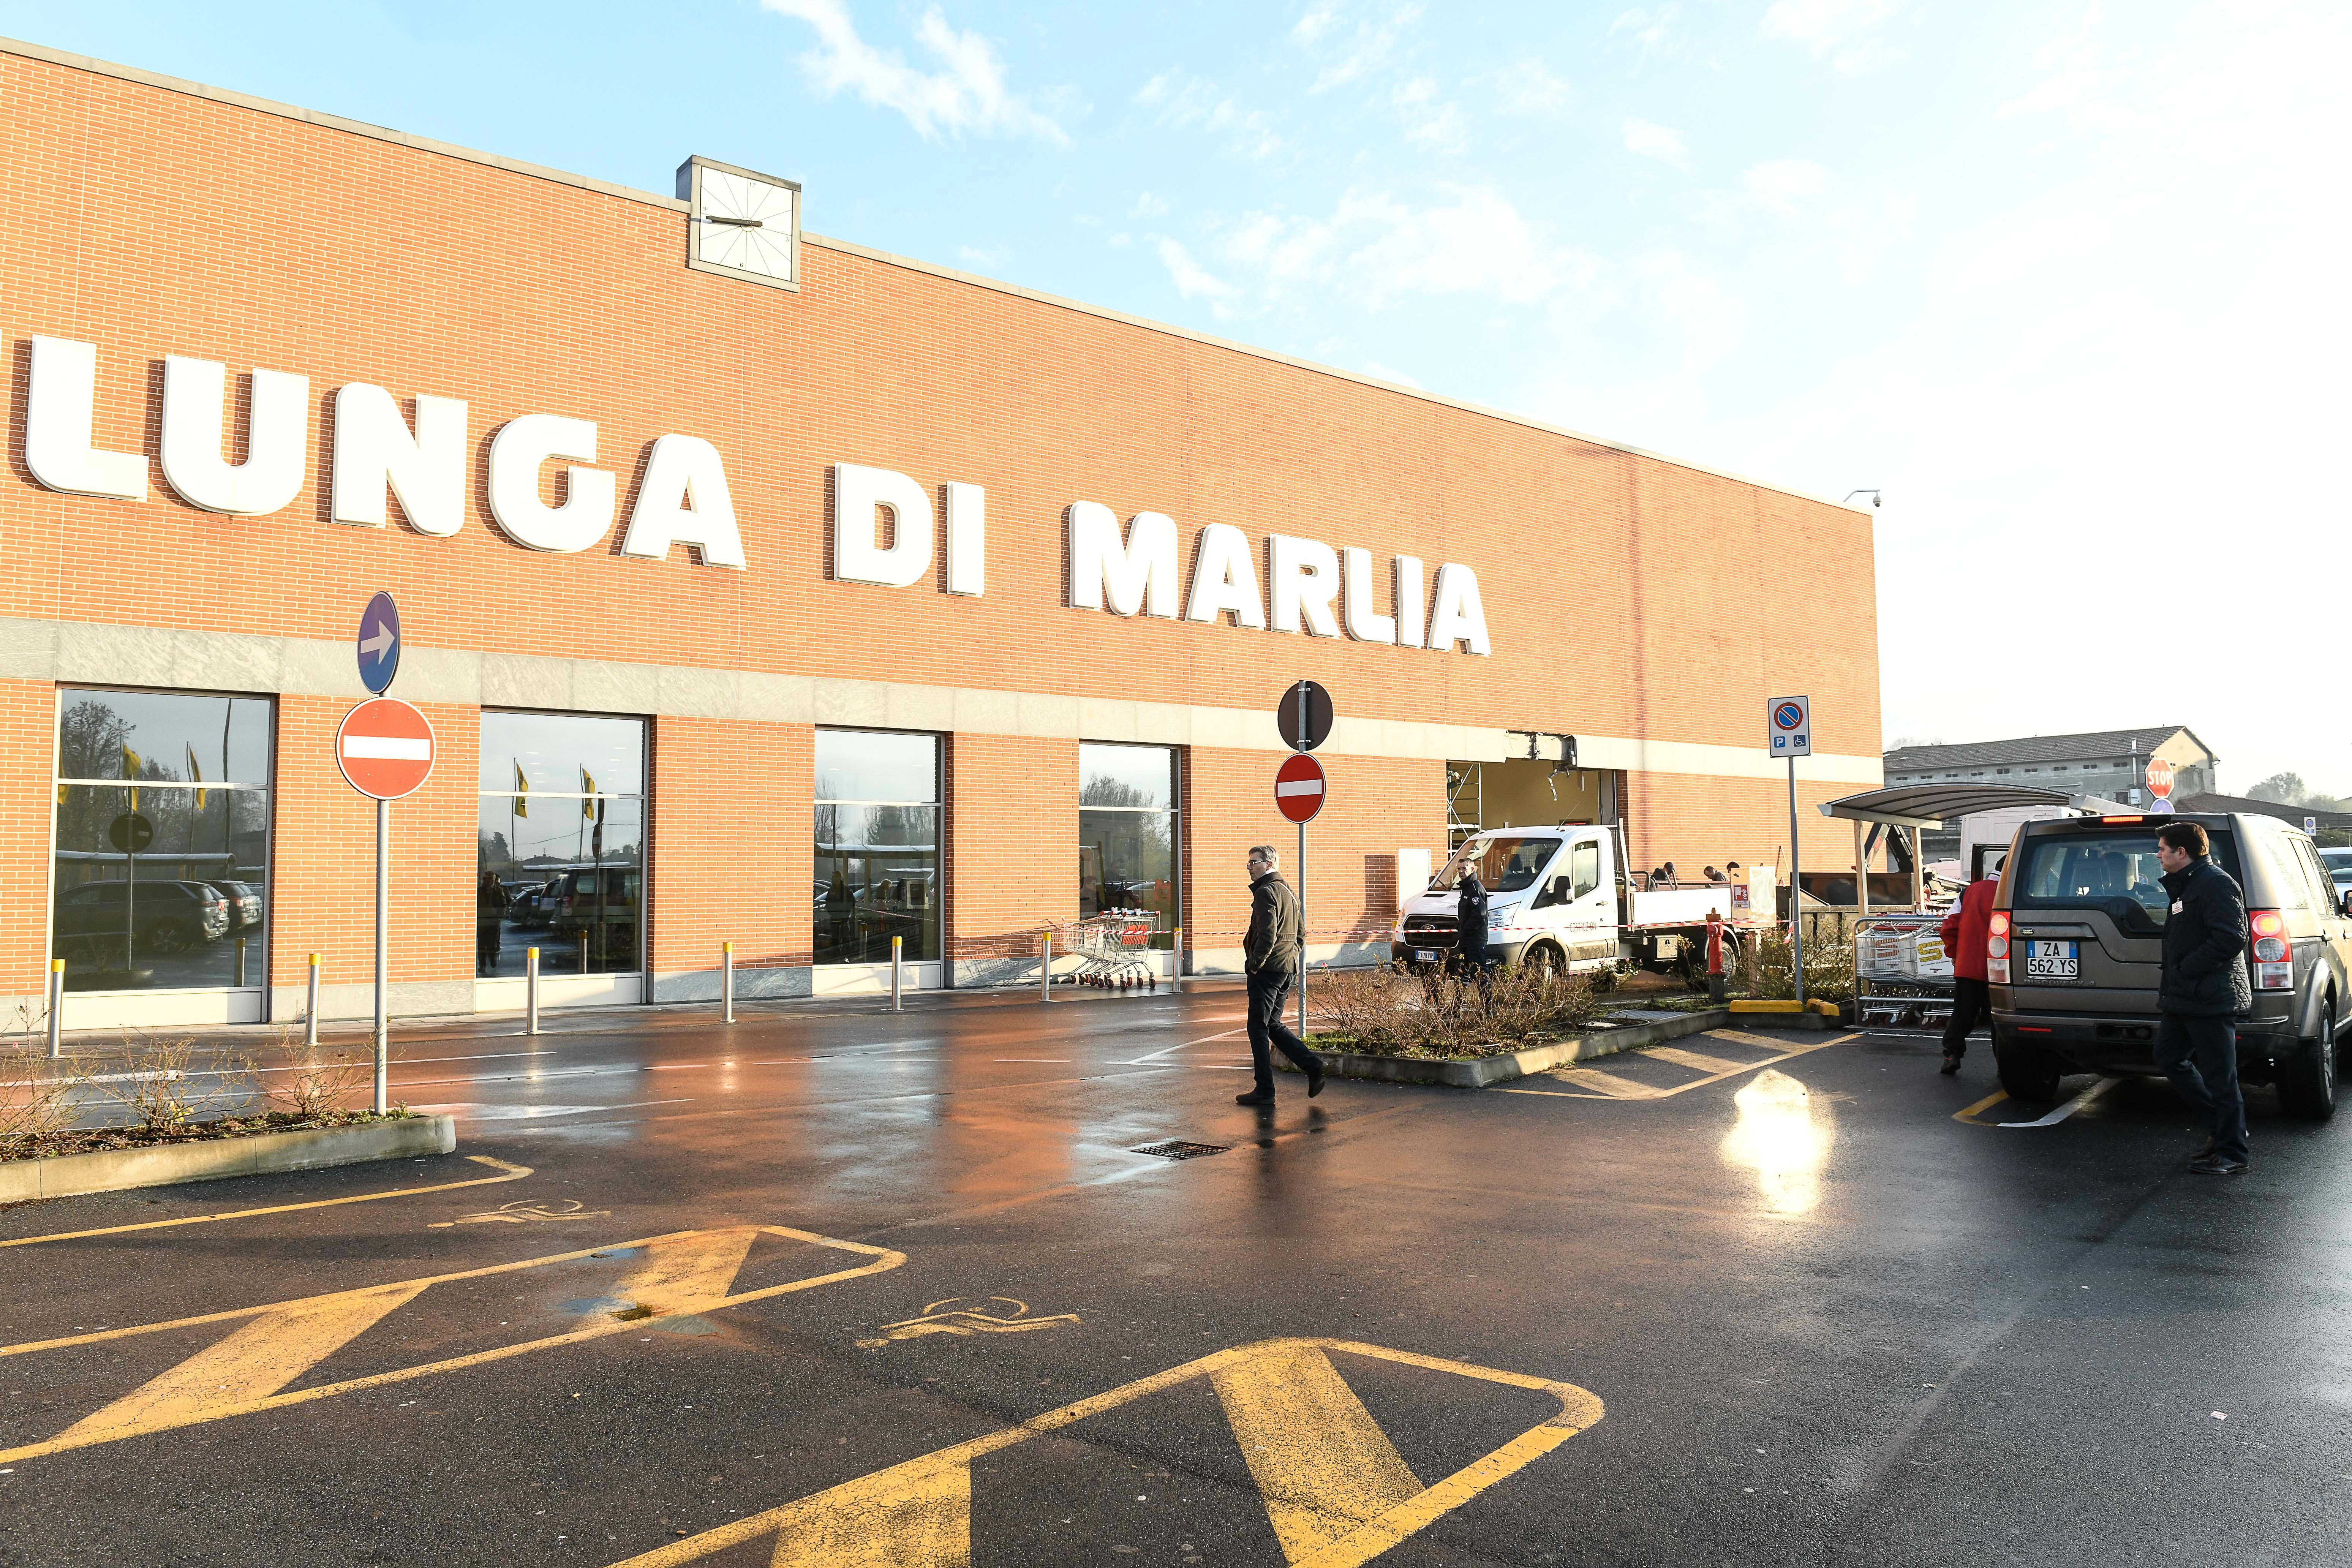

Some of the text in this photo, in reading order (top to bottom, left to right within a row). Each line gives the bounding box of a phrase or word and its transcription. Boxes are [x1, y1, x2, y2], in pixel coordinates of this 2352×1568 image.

[0, 330, 1491, 657] LUNGA DI MARLIA
[1776, 737, 1783, 747] P
[2148, 770, 2171, 785] STOP
[2044, 942, 2060, 956] ZA
[2029, 959, 2076, 974] 562 YS
